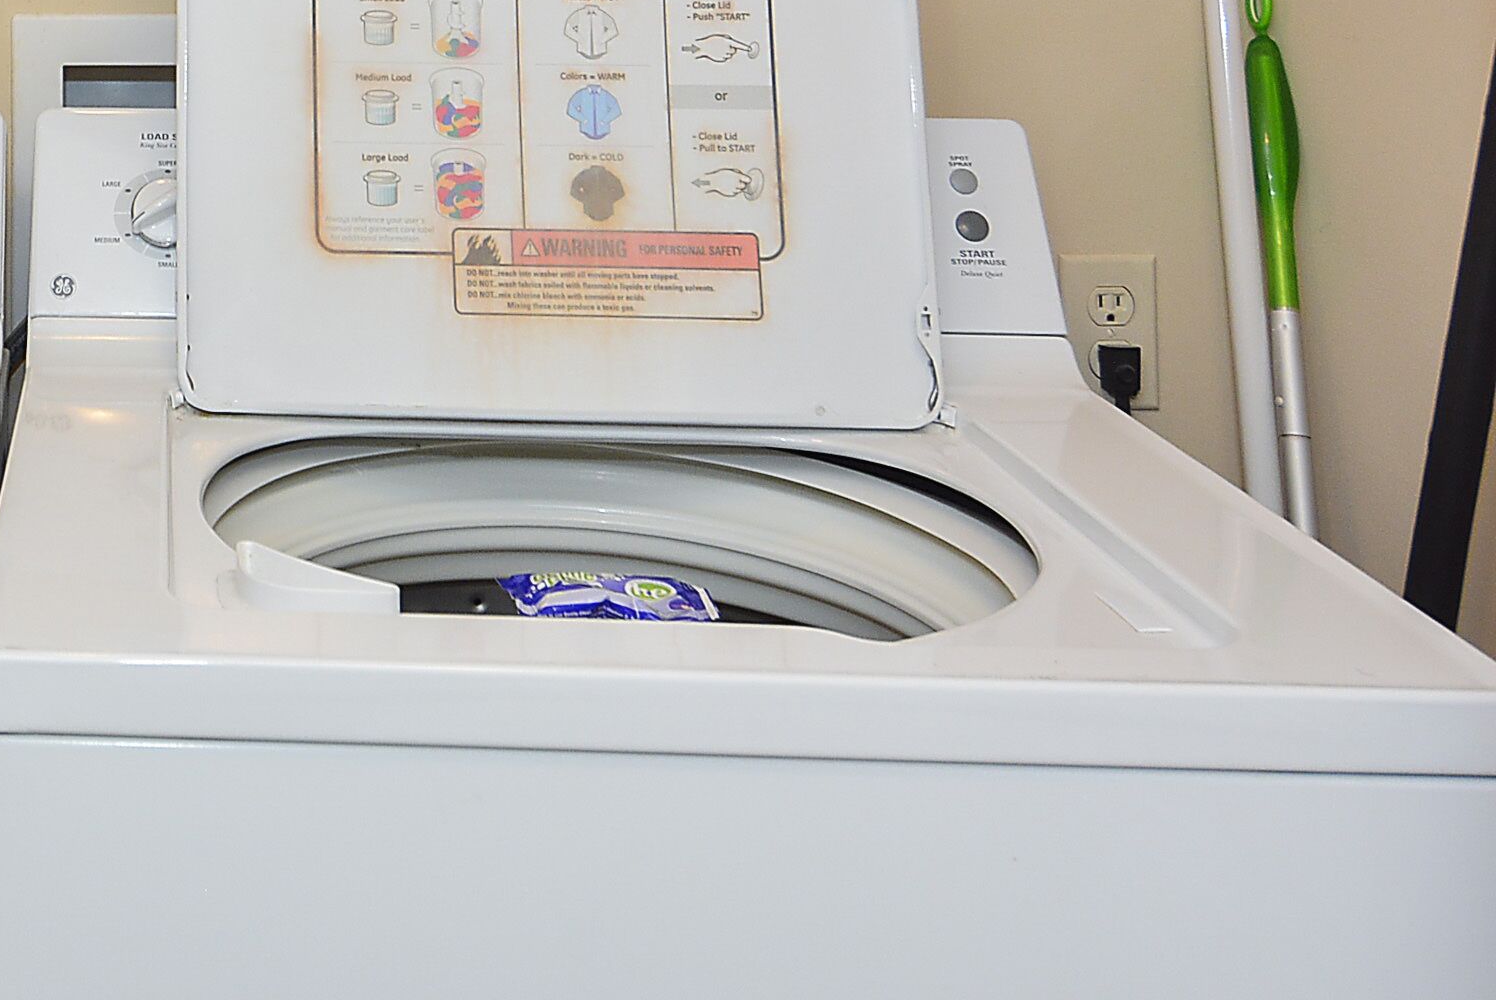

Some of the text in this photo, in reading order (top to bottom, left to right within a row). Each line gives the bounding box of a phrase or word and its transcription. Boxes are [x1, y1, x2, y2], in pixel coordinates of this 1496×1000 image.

[692, 1, 731, 10] Close Lid
[692, 13, 714, 21] Push
[355, 73, 412, 82] Medium Load
[560, 72, 626, 81] Colors WARM
[714, 92, 728, 101] or
[141, 133, 170, 141] LOAD
[698, 132, 738, 141] Close Lid
[699, 144, 755, 152] Pull to START
[361, 153, 409, 163] Large Load
[568, 153, 624, 161] Dark COLD
[540, 238, 627, 258] WARNING
[639, 245, 743, 257] FOR PERSONAL SAFETY
[959, 250, 995, 258] START
[950, 258, 1007, 266] STOP/PAUSE
[631, 582, 667, 599] he
